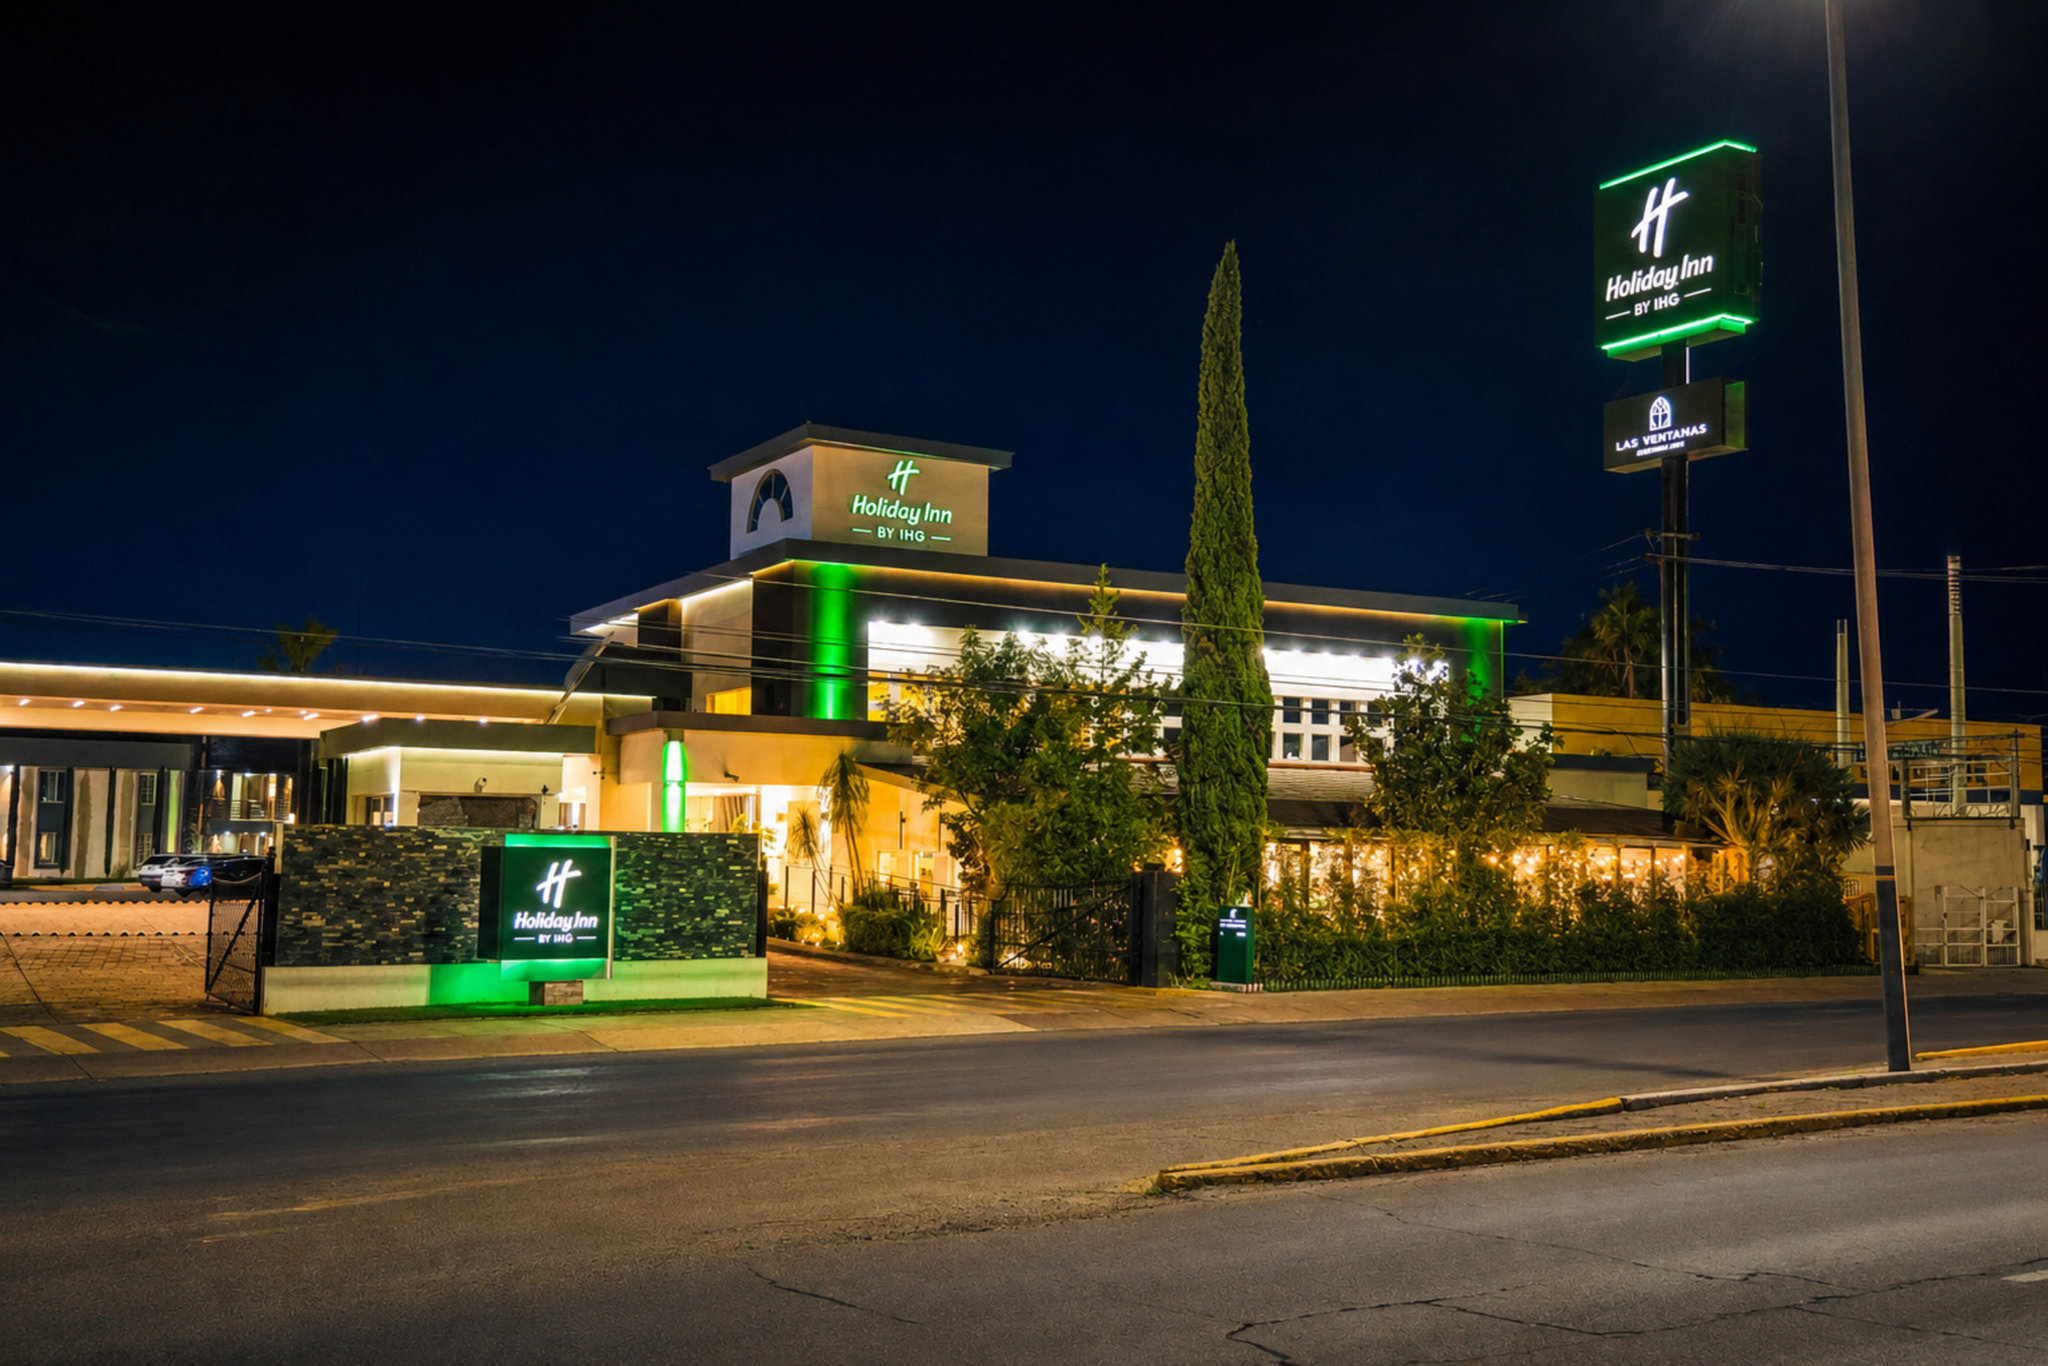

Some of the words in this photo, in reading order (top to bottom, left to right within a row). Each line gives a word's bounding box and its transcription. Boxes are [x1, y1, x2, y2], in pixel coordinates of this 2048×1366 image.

[1605, 264, 1680, 302] Holiday
[1680, 253, 1715, 280] Inn
[1633, 300, 1651, 317] BY
[1653, 292, 1681, 311] IHG
[1615, 438, 1640, 452] LAS
[1642, 423, 1708, 446] VENTANAS
[852, 494, 922, 526] Holiday
[923, 502, 953, 524] Inn
[877, 526, 895, 539] BY
[899, 528, 926, 543] IHG
[513, 910, 573, 932] Holiday
[573, 910, 599, 928] Inn
[537, 934, 552, 944] BY
[552, 933, 575, 944] IHG
